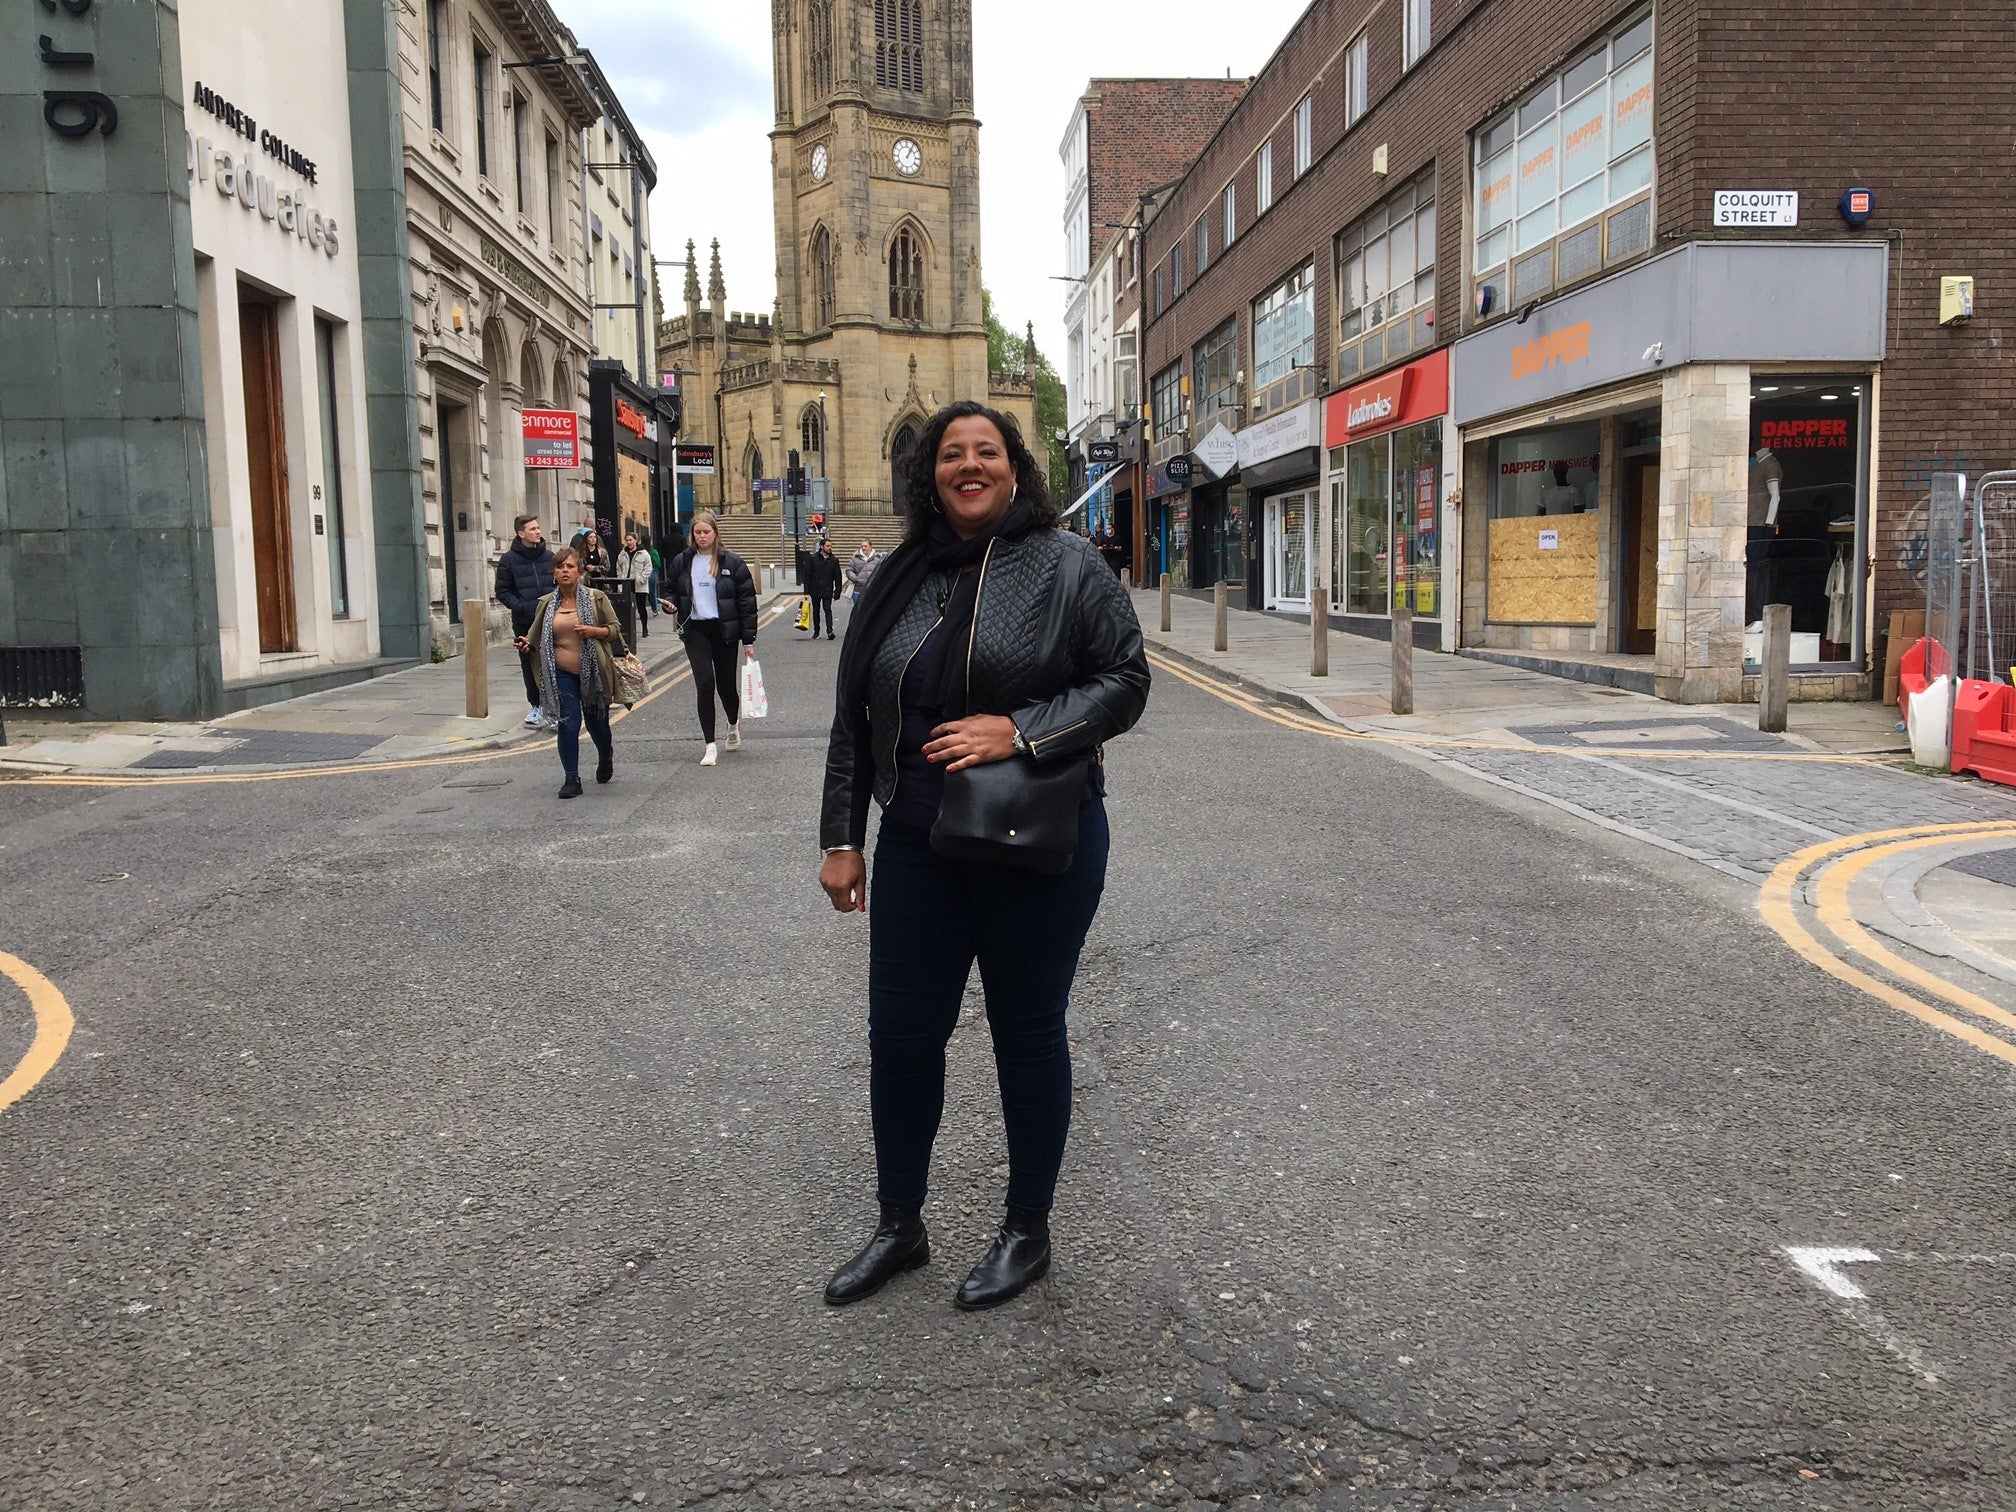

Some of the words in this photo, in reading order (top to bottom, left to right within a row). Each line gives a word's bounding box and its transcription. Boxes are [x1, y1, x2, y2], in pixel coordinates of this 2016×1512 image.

[1617, 82, 1653, 117] DAPPE
[194, 81, 257, 142] ANDREW
[261, 129, 319, 185] COLLINGE
[1566, 114, 1603, 151] DAPPER
[1522, 146, 1554, 180] DAPPER
[1482, 175, 1511, 204] DAPPER
[1718, 193, 1794, 208] COLQUITT
[1720, 210, 1778, 223] STREET
[1784, 215, 1792, 223] L1
[1511, 320, 1592, 382] DAPPER
[1347, 392, 1392, 428] Ladbrokes
[521, 415, 572, 429] enmore
[1762, 419, 1847, 436] DAPPER
[553, 441, 561, 449] to
[1207, 437, 1235, 448] whisc
[1762, 436, 1848, 448] MENSWEAR
[536, 457, 552, 465] 243
[553, 458, 573, 466] 5325
[678, 450, 712, 459] Sainsbury's
[693, 457, 713, 465] Local
[1501, 459, 1546, 475] DAPPER
[1549, 455, 1600, 471] MENSWEA
[313, 485, 321, 500] 99
